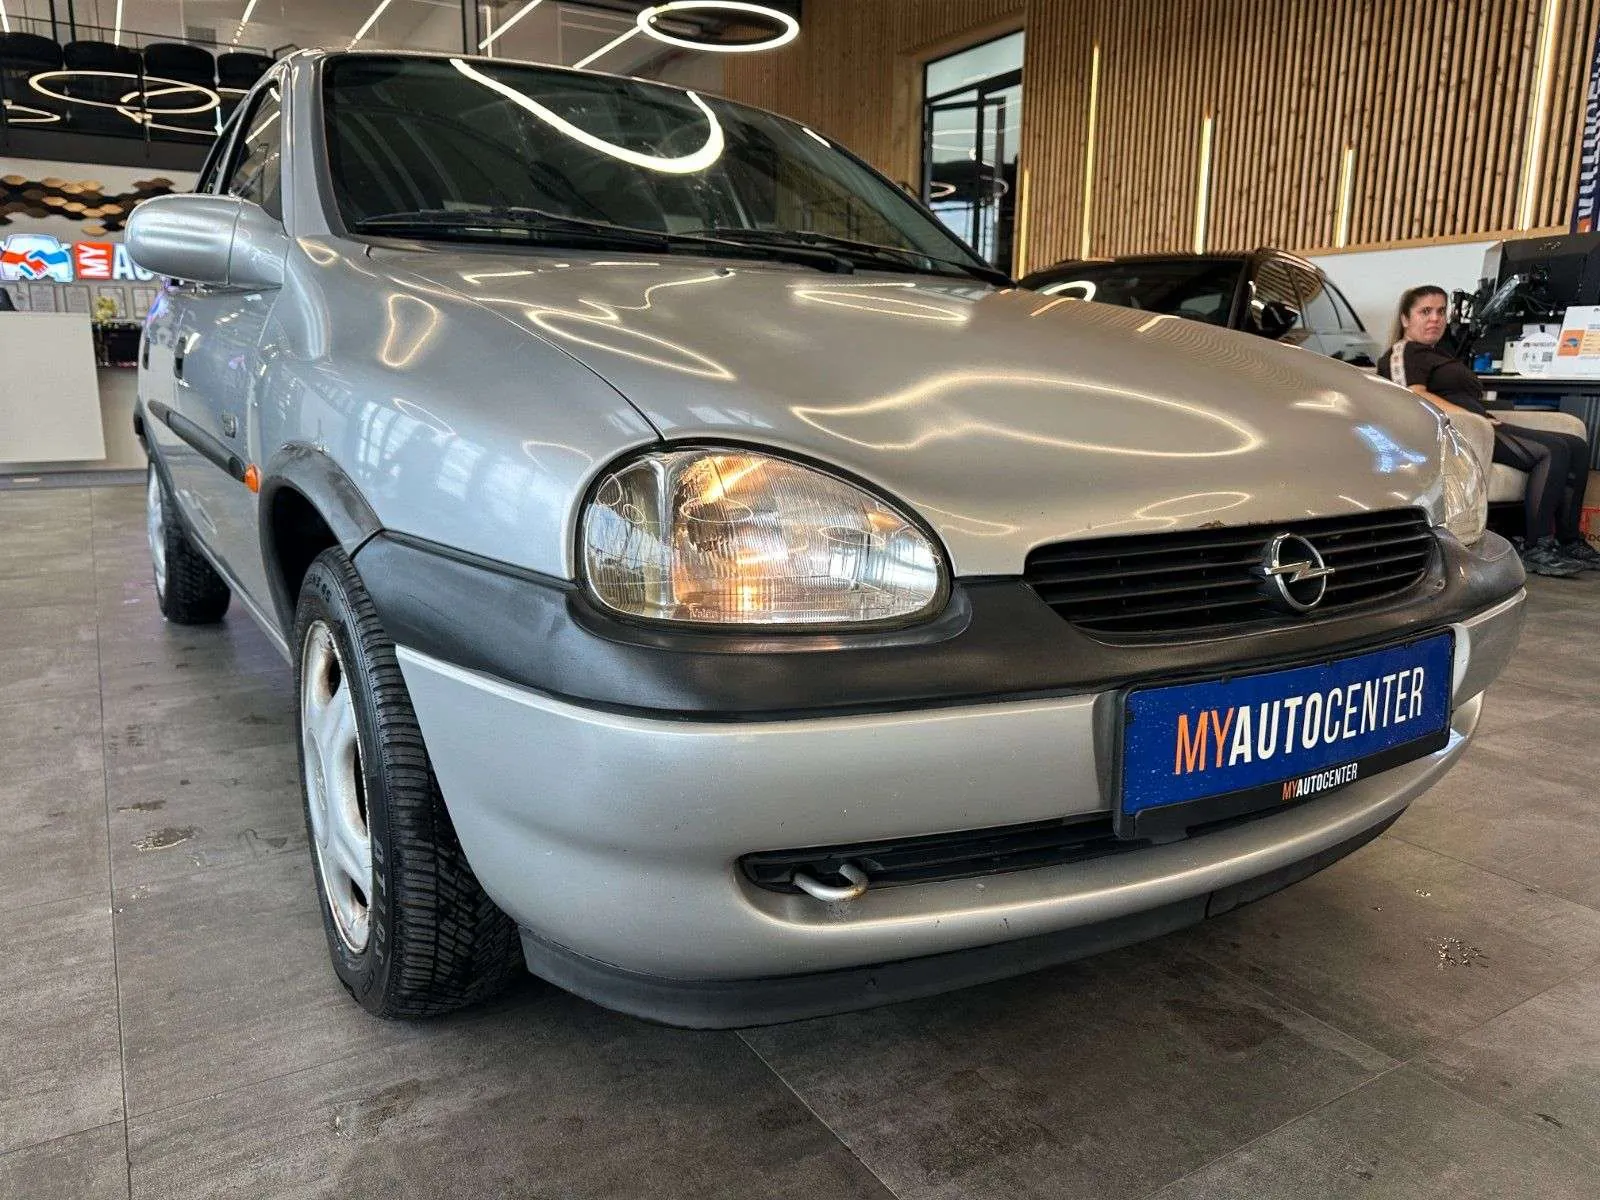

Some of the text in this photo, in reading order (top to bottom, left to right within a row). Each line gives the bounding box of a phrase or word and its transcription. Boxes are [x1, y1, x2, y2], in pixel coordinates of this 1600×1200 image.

[79, 244, 110, 277] MY
[1172, 666, 1425, 776] MYAUTOCENTER
[1282, 763, 1358, 801] MYAUTOCENTER
